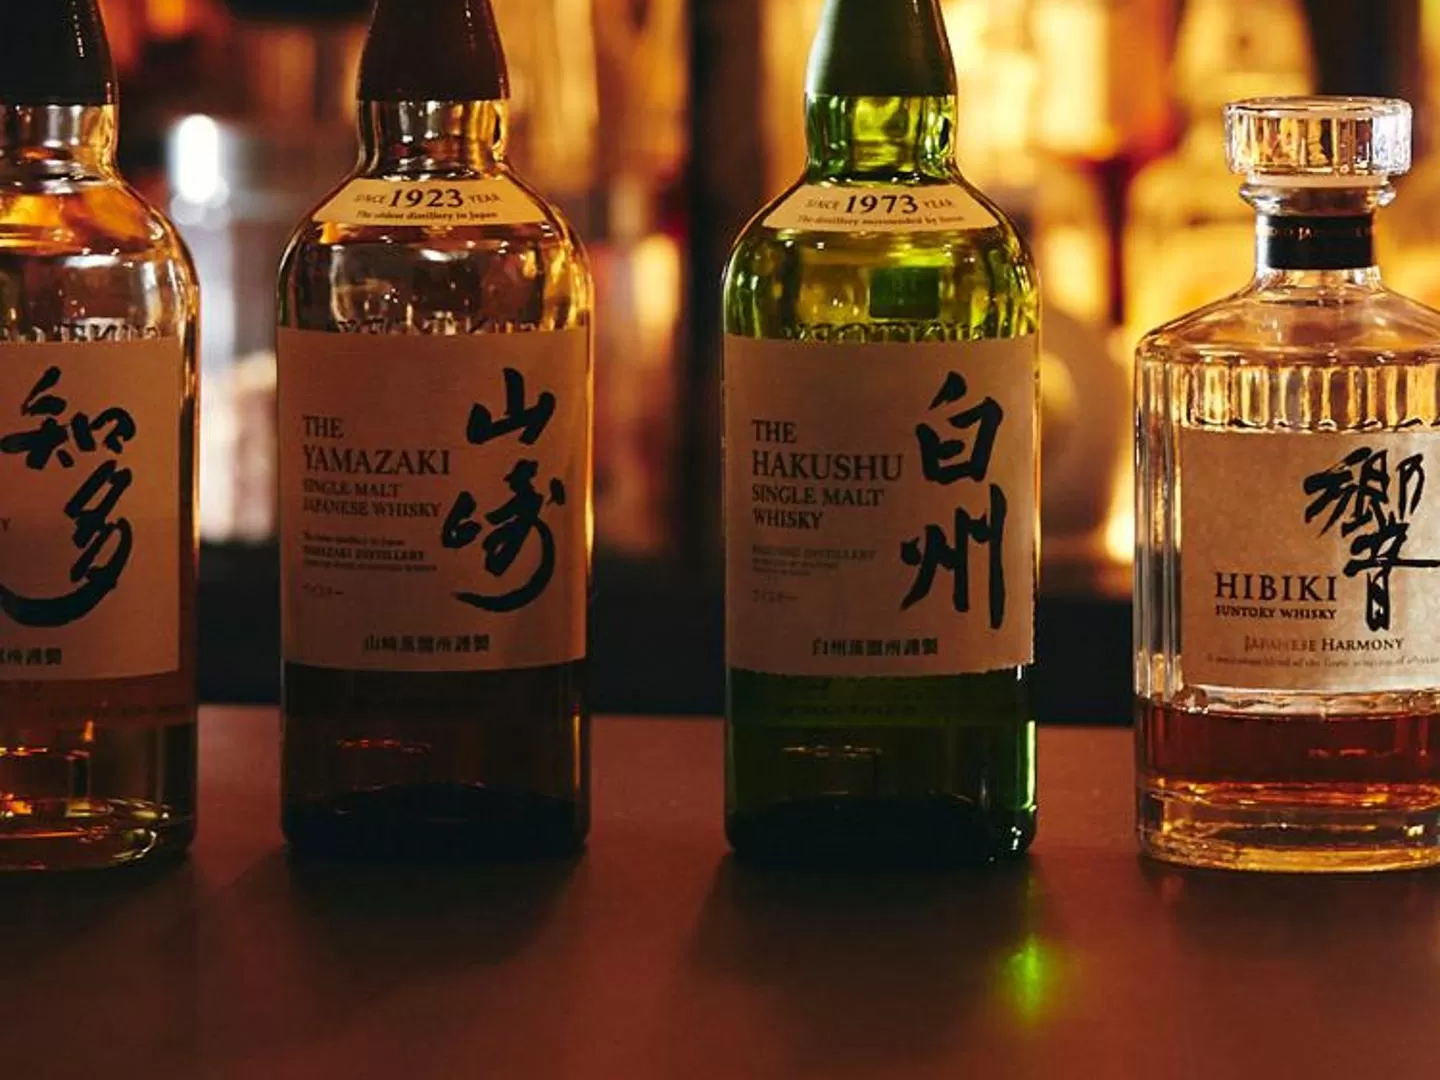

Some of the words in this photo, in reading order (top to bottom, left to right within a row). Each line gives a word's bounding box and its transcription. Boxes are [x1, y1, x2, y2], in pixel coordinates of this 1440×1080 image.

[389, 188, 464, 208] 1923
[845, 193, 919, 214] 1973
[302, 414, 345, 439] THE
[751, 419, 798, 444] THE
[302, 443, 450, 476] YAMAZAKI
[751, 448, 905, 482] HAKUSHU
[355, 482, 403, 498] MALT
[751, 483, 817, 505] SINGLE
[821, 487, 885, 507] MALT
[900, 370, 1008, 631] 白州
[371, 500, 442, 518] WHISKY
[751, 507, 825, 530] WHISKY
[1214, 571, 1338, 602] HIBIKI
[1214, 604, 1276, 619] SUNTORY
[1279, 606, 1338, 621] WHISKY
[1320, 637, 1405, 653] HARMONY
